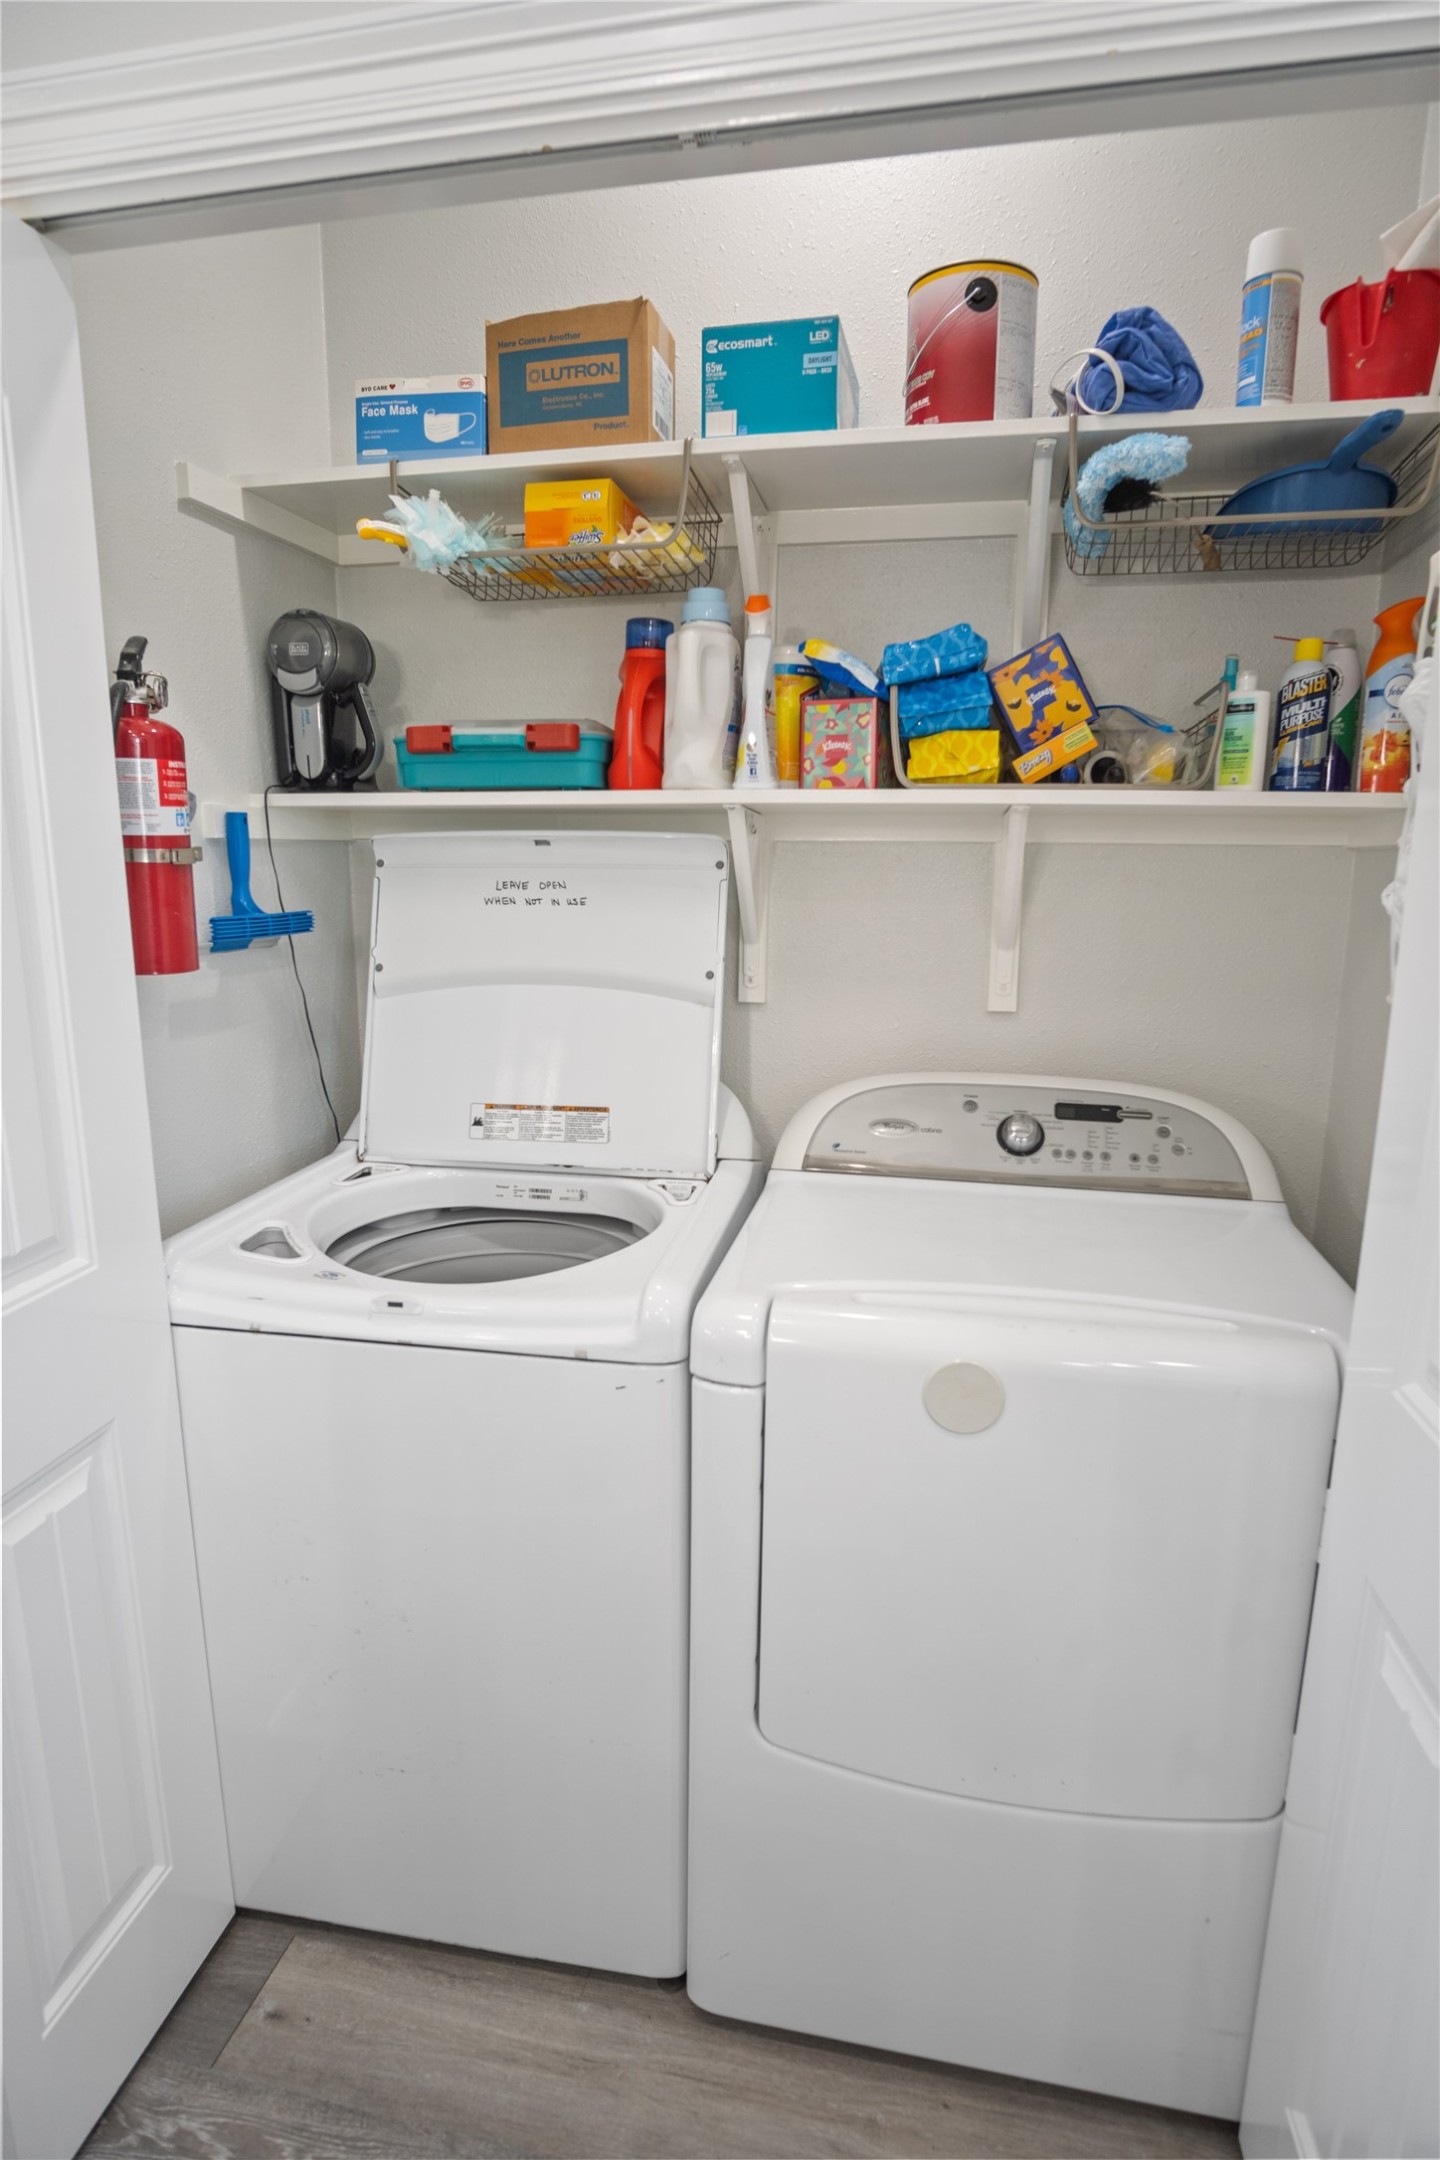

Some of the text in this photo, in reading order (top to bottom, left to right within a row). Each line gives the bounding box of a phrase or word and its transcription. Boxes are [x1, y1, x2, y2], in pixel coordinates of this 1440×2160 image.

[497, 332, 582, 350] Here Comes Another
[717, 334, 774, 351] ecosmart
[809, 330, 830, 342] LED
[807, 355, 833, 364] DAYLIGHT
[361, 404, 419, 418] Face Mask
[568, 529, 605, 546] Swiffer
[1026, 685, 1056, 707] Kleenex
[1279, 708, 1325, 732] PURPOSE
[822, 740, 852, 752] Kleenex
[1019, 748, 1053, 775] Breezy
[495, 880, 567, 891] LEAVE OPEN
[483, 896, 588, 906] WHEN NOT IN USE
